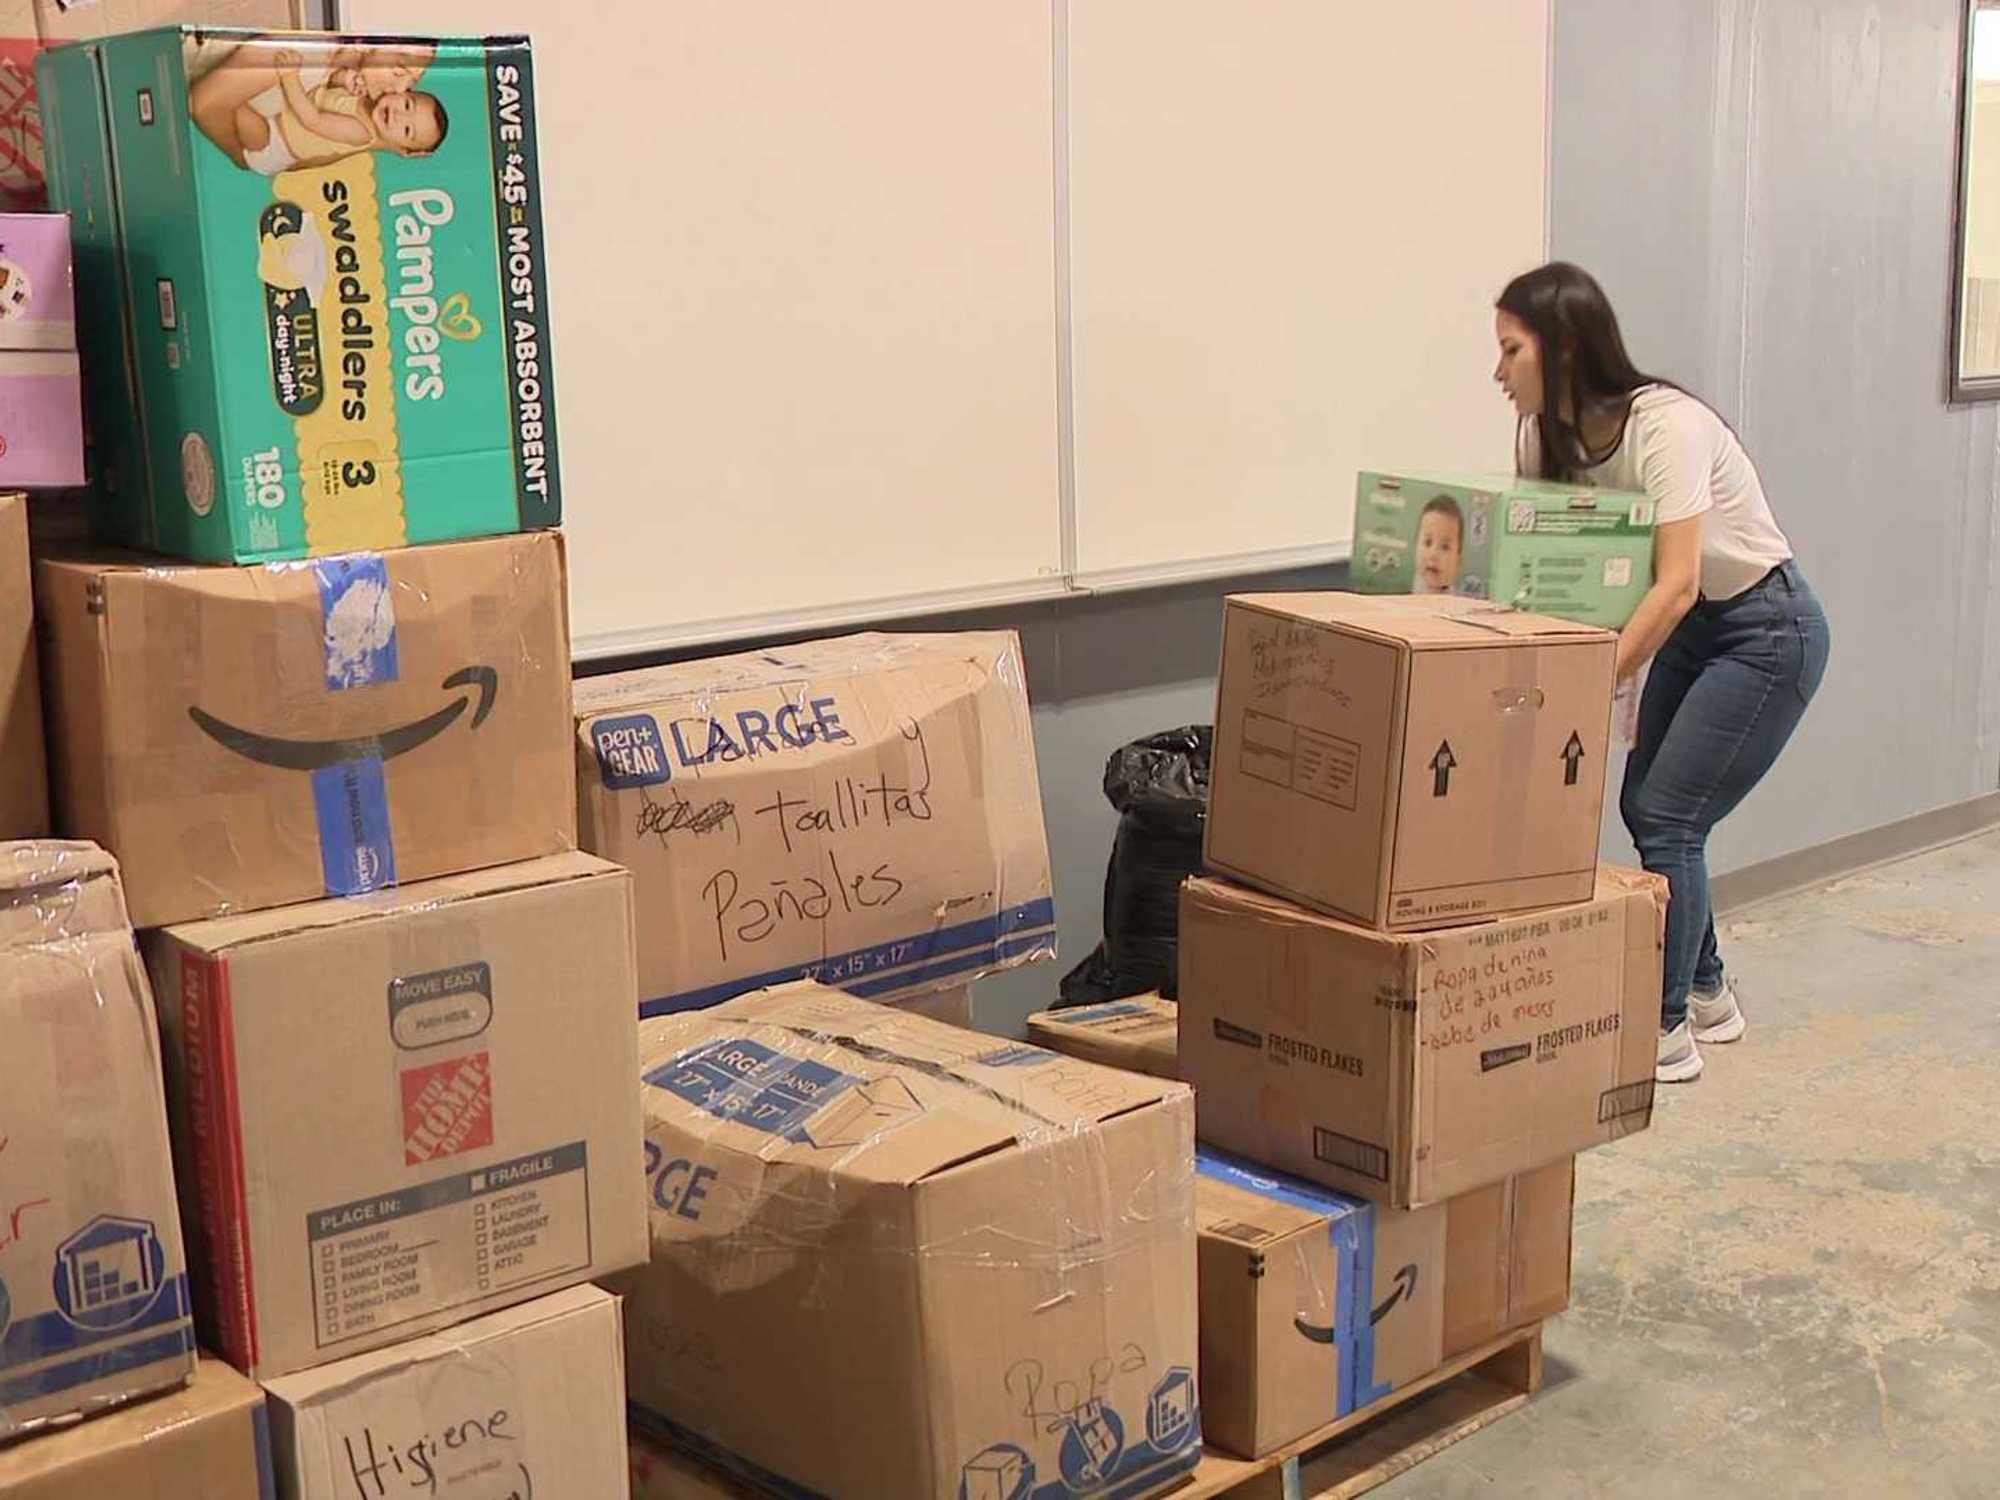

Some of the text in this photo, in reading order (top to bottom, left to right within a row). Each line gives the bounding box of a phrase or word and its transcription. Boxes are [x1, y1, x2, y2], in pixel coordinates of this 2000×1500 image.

[496, 65, 523, 142] SAVE
[507, 227, 534, 313] MOST
[322, 180, 374, 421] swaddlers
[389, 188, 454, 401] Pampers
[293, 314, 319, 399] ULTRA
[513, 320, 547, 502] ABSORBENT
[254, 446, 285, 508] 180
[342, 460, 376, 488] 3
[670, 697, 850, 767] LARGE
[610, 744, 658, 777] GEAR
[702, 850, 903, 961] Pañales
[400, 970, 484, 999] MOVE EASY
[1536, 1012, 1621, 1052] FROSTED FLAKES
[717, 1050, 769, 1079] ARGE
[1268, 1033, 1319, 1064] FROSTED
[1320, 1048, 1364, 1077] FLAKES
[407, 1056, 487, 1160] HOME
[489, 1156, 553, 1186] FRAGILE
[320, 1199, 402, 1231] PLACE IN:
[492, 1190, 538, 1210] KITCHEN
[492, 1204, 541, 1226] LAUNDRY
[340, 1230, 391, 1251] PRIMARY
[492, 1214, 549, 1240] BASEMENT
[341, 1243, 399, 1266] BEDROOM
[493, 1235, 537, 1256] GARAGE
[342, 1253, 418, 1283] FAMILY ROOM
[494, 1253, 523, 1271] ATTIC
[343, 1270, 417, 1298] LIVING ROOM
[384, 1284, 420, 1303] ROOM
[1004, 1342, 1147, 1440] Ropa
[344, 1409, 516, 1500] Higiene
